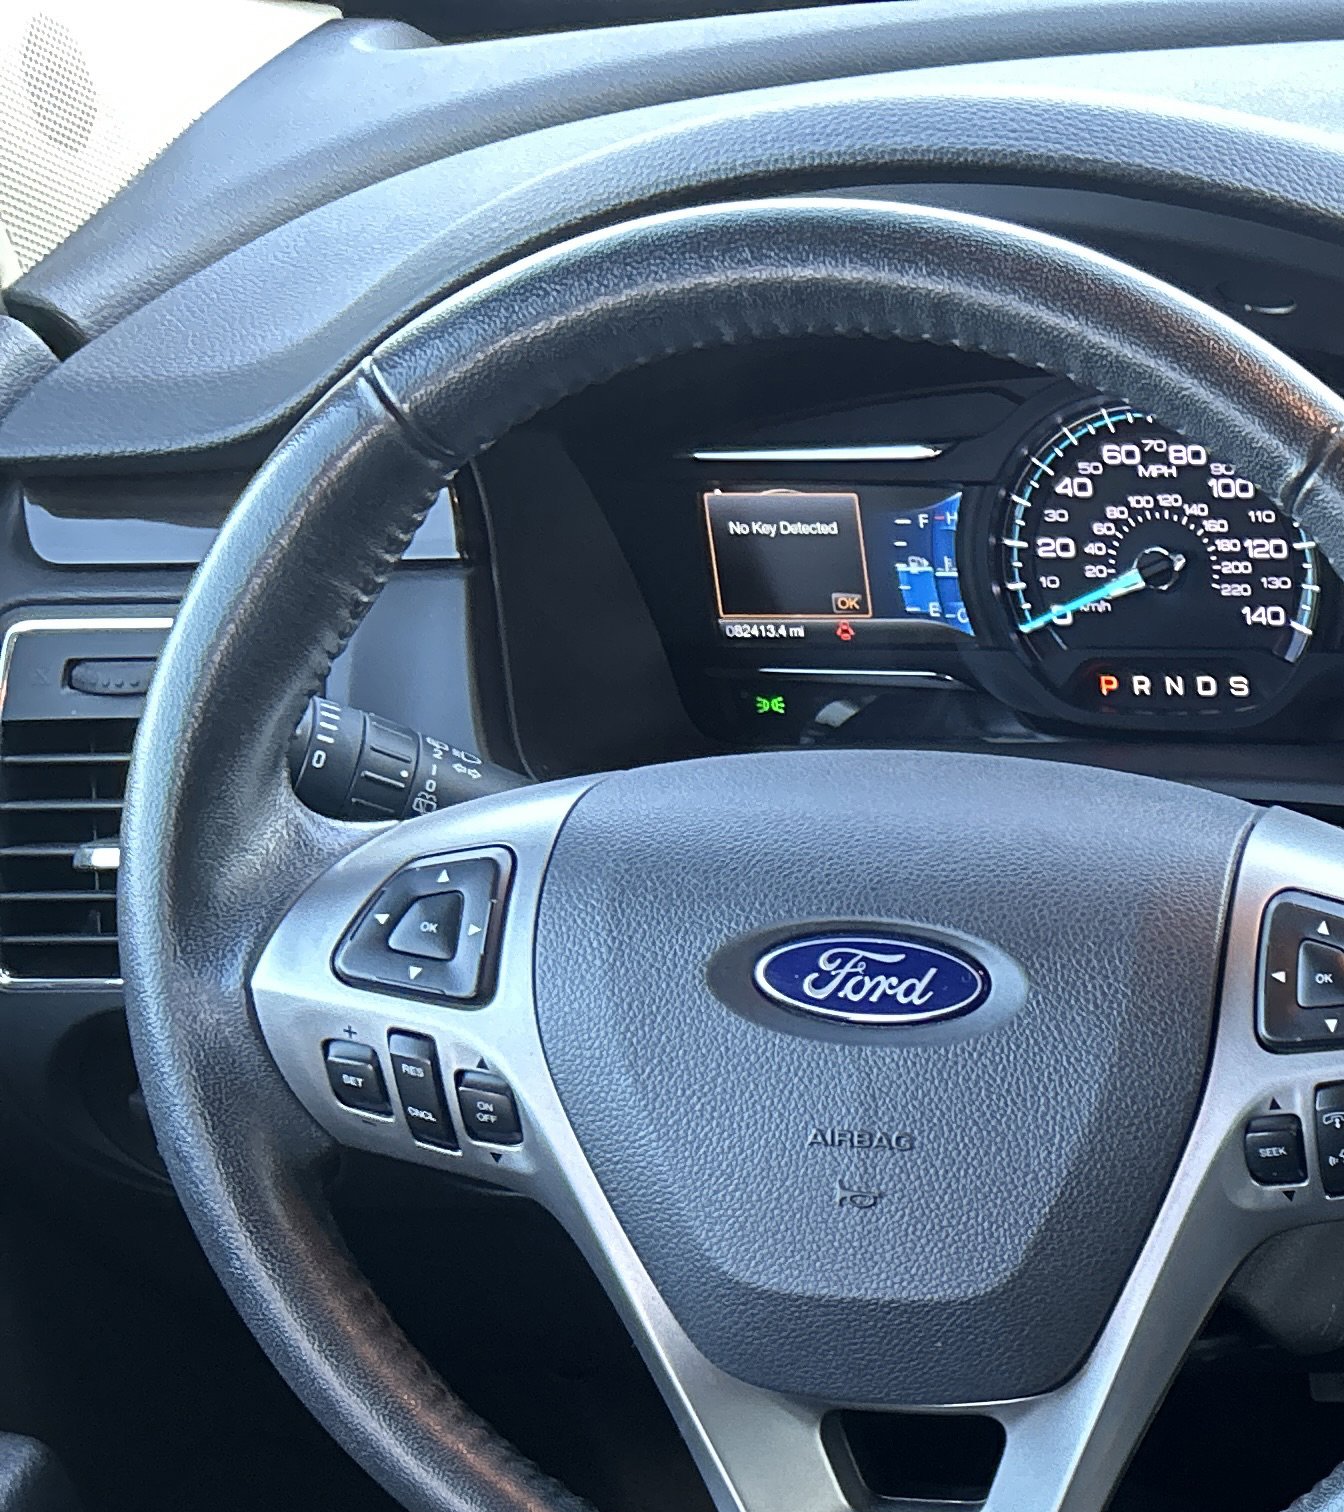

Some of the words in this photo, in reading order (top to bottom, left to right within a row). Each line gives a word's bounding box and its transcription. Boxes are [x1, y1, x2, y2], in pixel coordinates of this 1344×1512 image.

[1141, 439, 1167, 452] 70
[1102, 444, 1141, 465] 60
[1169, 444, 1207, 465] 80
[1078, 462, 1103, 475] 50
[1137, 465, 1177, 478] MPH
[1055, 477, 1093, 498] 40
[1208, 478, 1254, 498] 100
[1127, 496, 1154, 508] 100
[1156, 494, 1182, 507] 120
[1044, 509, 1069, 523] 30
[1105, 506, 1129, 519] 80
[1183, 504, 1209, 516] 140
[1248, 511, 1276, 523] 110
[918, 513, 929, 528] F
[945, 511, 958, 526] H
[728, 521, 749, 535] No
[751, 521, 777, 538] Key
[779, 521, 838, 535] Detected
[1093, 522, 1116, 536] 60
[1202, 519, 1229, 533] 160
[1036, 538, 1076, 558] 20
[1084, 543, 1107, 555] 40
[1214, 538, 1241, 552] 180
[1243, 538, 1288, 559] 120
[1084, 565, 1107, 578] 20
[1221, 561, 1252, 575] 200
[1039, 576, 1060, 588] 10
[1260, 577, 1292, 589] 130
[1220, 583, 1252, 597] 220
[837, 597, 860, 610] OK
[929, 601, 941, 617] E
[1050, 604, 1073, 626] 0
[1241, 605, 1286, 626] 140
[725, 624, 787, 639] 082413.4
[789, 625, 804, 638] mi
[1099, 675, 1119, 695] P
[1132, 676, 1151, 695] R
[1165, 676, 1184, 695] N
[1196, 676, 1217, 695] D
[1229, 676, 1249, 695] S
[420, 921, 438, 933] OK
[802, 947, 938, 1006] Ford
[1315, 973, 1334, 984] OK
[476, 1101, 494, 1112] ON
[476, 1112, 497, 1124] OFF
[807, 1128, 914, 1151] AIRBAG
[1259, 1147, 1287, 1158] SEEK
